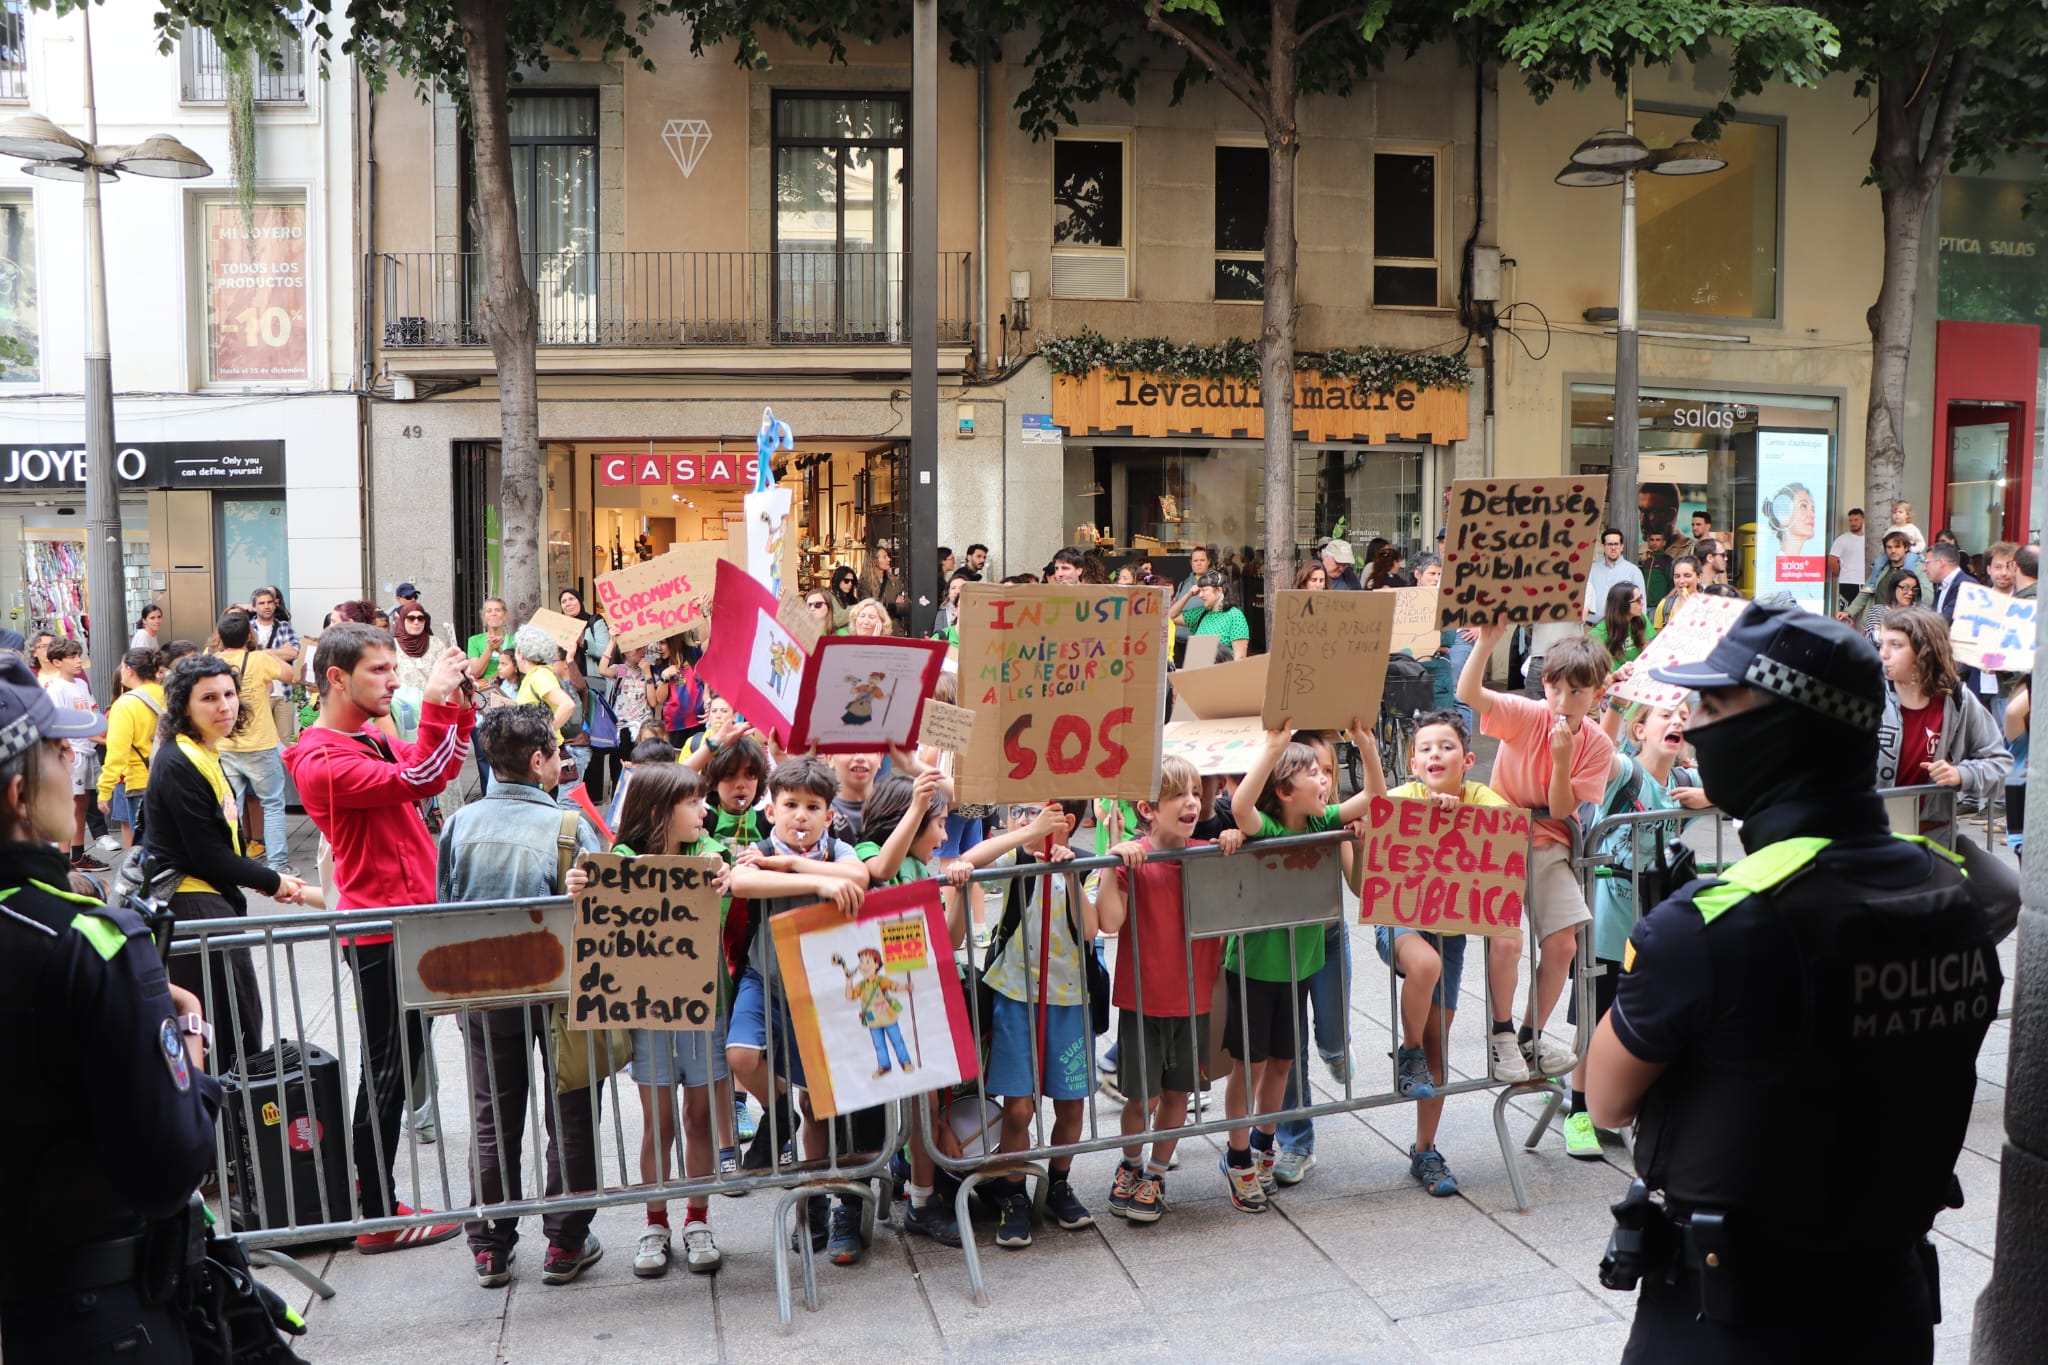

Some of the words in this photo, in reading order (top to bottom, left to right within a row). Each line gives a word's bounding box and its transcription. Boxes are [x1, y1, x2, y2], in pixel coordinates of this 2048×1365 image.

[219, 228, 237, 239] MI
[242, 226, 302, 239] JOYERO
[1939, 237, 1981, 254] PTICA
[1990, 241, 2036, 257] SALAS
[221, 264, 267, 274] TODOS
[272, 262, 298, 273] LOS
[217, 277, 303, 288] PRODUCTOS
[261, 367, 269, 375] de
[271, 366, 305, 375] diciembre
[402, 424, 423, 439] 49
[3, 449, 147, 482] JOYEO
[181, 468, 196, 476] can
[199, 466, 226, 476] define
[229, 466, 264, 478] yourself
[222, 456, 244, 467] Only
[245, 457, 260, 466] you
[269, 507, 281, 516] 47
[598, 580, 622, 603] EL
[1456, 584, 1496, 607] de
[985, 632, 1149, 662] MANIFESTACIÓ
[1281, 639, 1309, 660] NO
[980, 657, 1022, 684] MÉS
[1034, 659, 1136, 684] RECURSOS
[982, 686, 998, 705] A
[1008, 682, 1034, 702] LES
[1003, 706, 1134, 780] SOS
[1370, 795, 1529, 841] DEFENSA
[1368, 834, 1527, 881] L'ESCOLA
[581, 896, 699, 927] l'escola
[1362, 873, 1524, 927] PÚBLICA
[576, 929, 699, 962] pública
[885, 938, 922, 954] NO
[580, 962, 622, 994] de
[1854, 949, 1988, 1004] POLICIA
[576, 981, 716, 1025] Mataró
[1853, 987, 1988, 1038] MATARÓ
[1060, 1037, 1085, 1064] SURF
